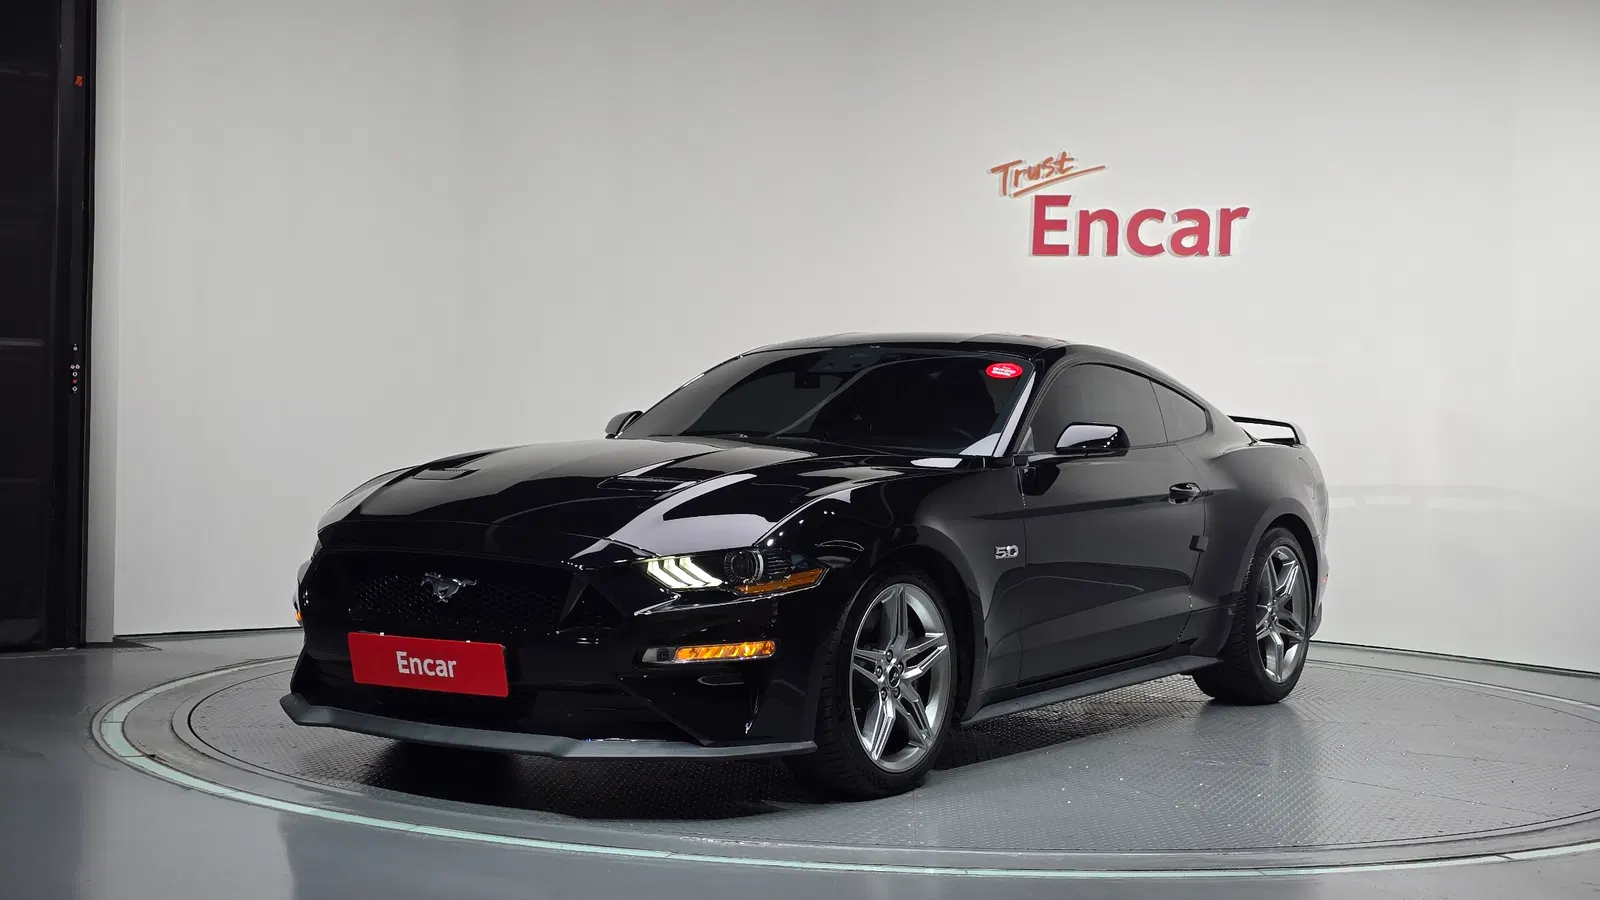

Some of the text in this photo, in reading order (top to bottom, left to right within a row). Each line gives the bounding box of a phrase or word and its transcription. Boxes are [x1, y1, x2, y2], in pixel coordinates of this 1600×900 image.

[990, 151, 1076, 196] Trust
[1030, 194, 1250, 257] Encar
[395, 650, 457, 678] Encar
